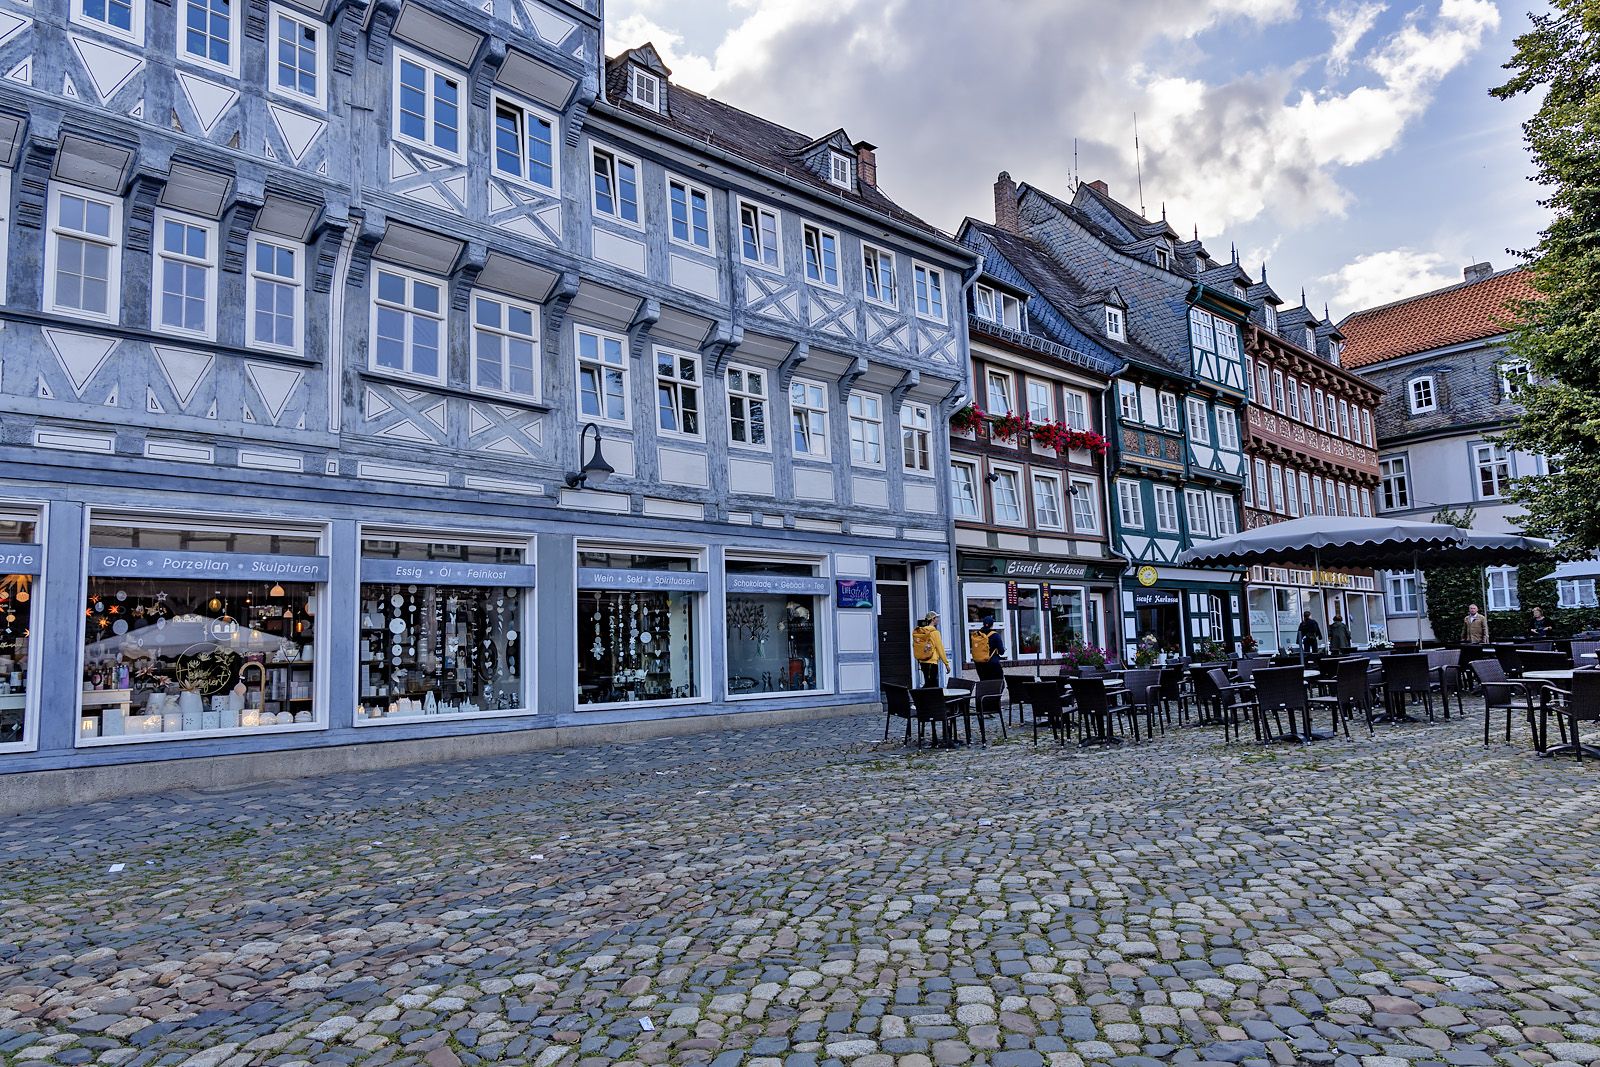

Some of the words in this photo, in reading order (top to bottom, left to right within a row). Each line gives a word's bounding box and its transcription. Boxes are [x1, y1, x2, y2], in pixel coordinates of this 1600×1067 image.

[102, 555, 138, 568] Glas
[162, 557, 230, 571] Porzellan
[251, 561, 319, 575] Skulpturen
[395, 566, 423, 579] Essig
[439, 565, 452, 577] Öl
[467, 569, 507, 580] Feinkost
[1007, 561, 1043, 575] Eiscafé
[1046, 563, 1085, 576] Karkossa
[593, 573, 614, 583] Wein
[626, 574, 643, 583] Sekt
[654, 575, 696, 585] Spirituosen
[733, 579, 772, 588] Schokolade
